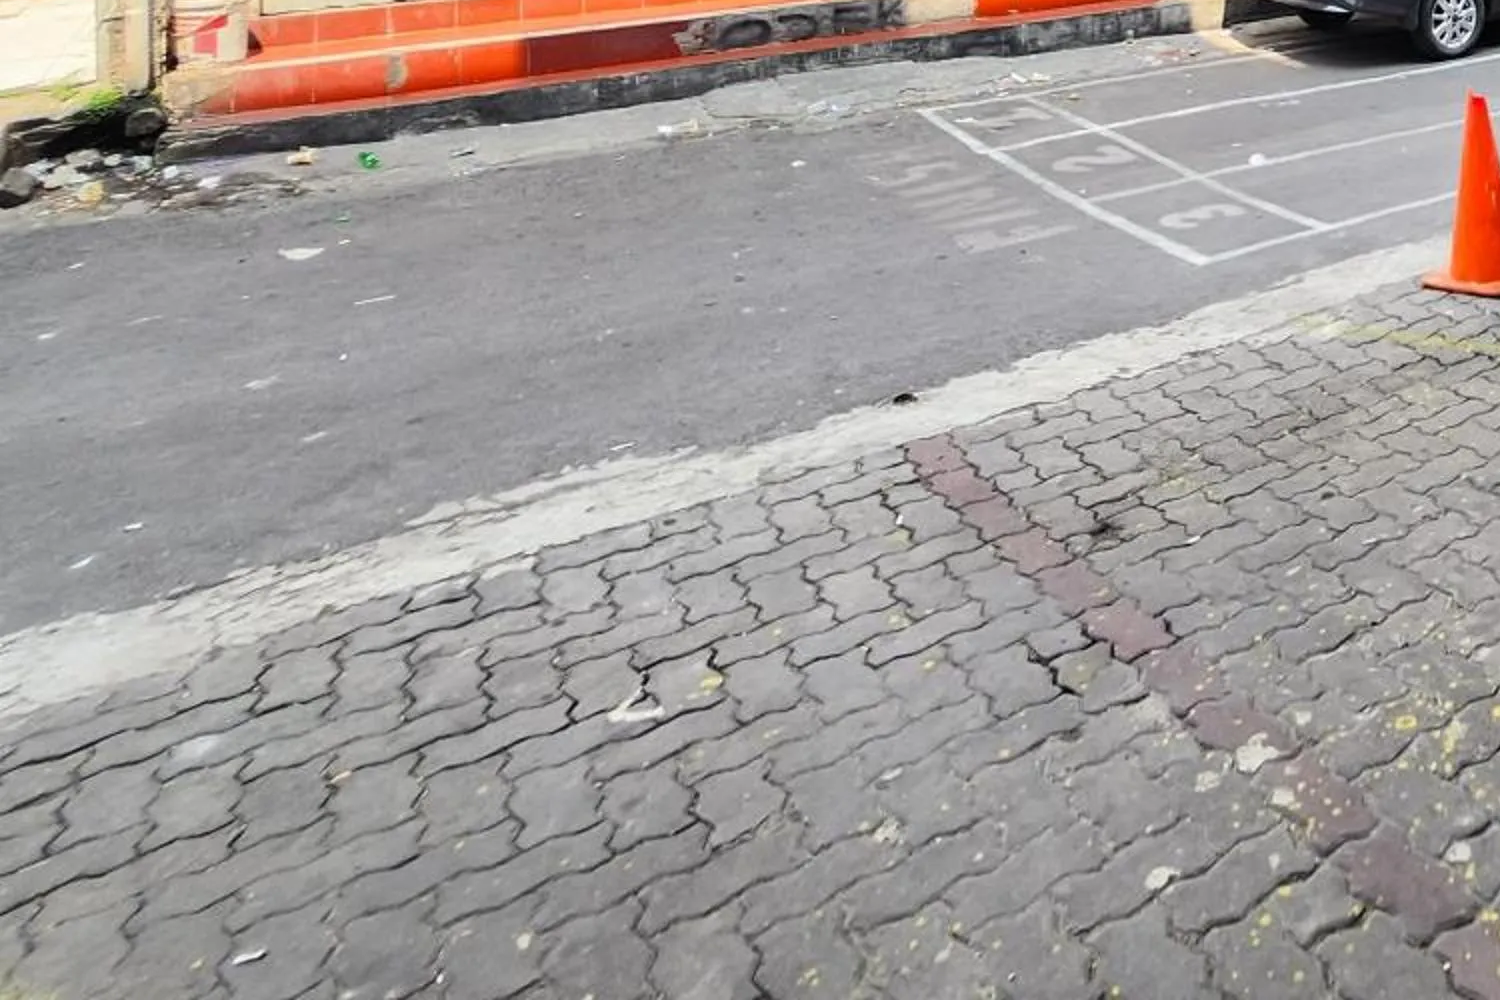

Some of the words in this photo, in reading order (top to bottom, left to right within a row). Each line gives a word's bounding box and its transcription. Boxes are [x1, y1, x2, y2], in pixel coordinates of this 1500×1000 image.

[951, 106, 1053, 130] 1
[1051, 144, 1138, 174] 2
[853, 141, 1079, 256] FINISH
[1158, 203, 1248, 230] 3
